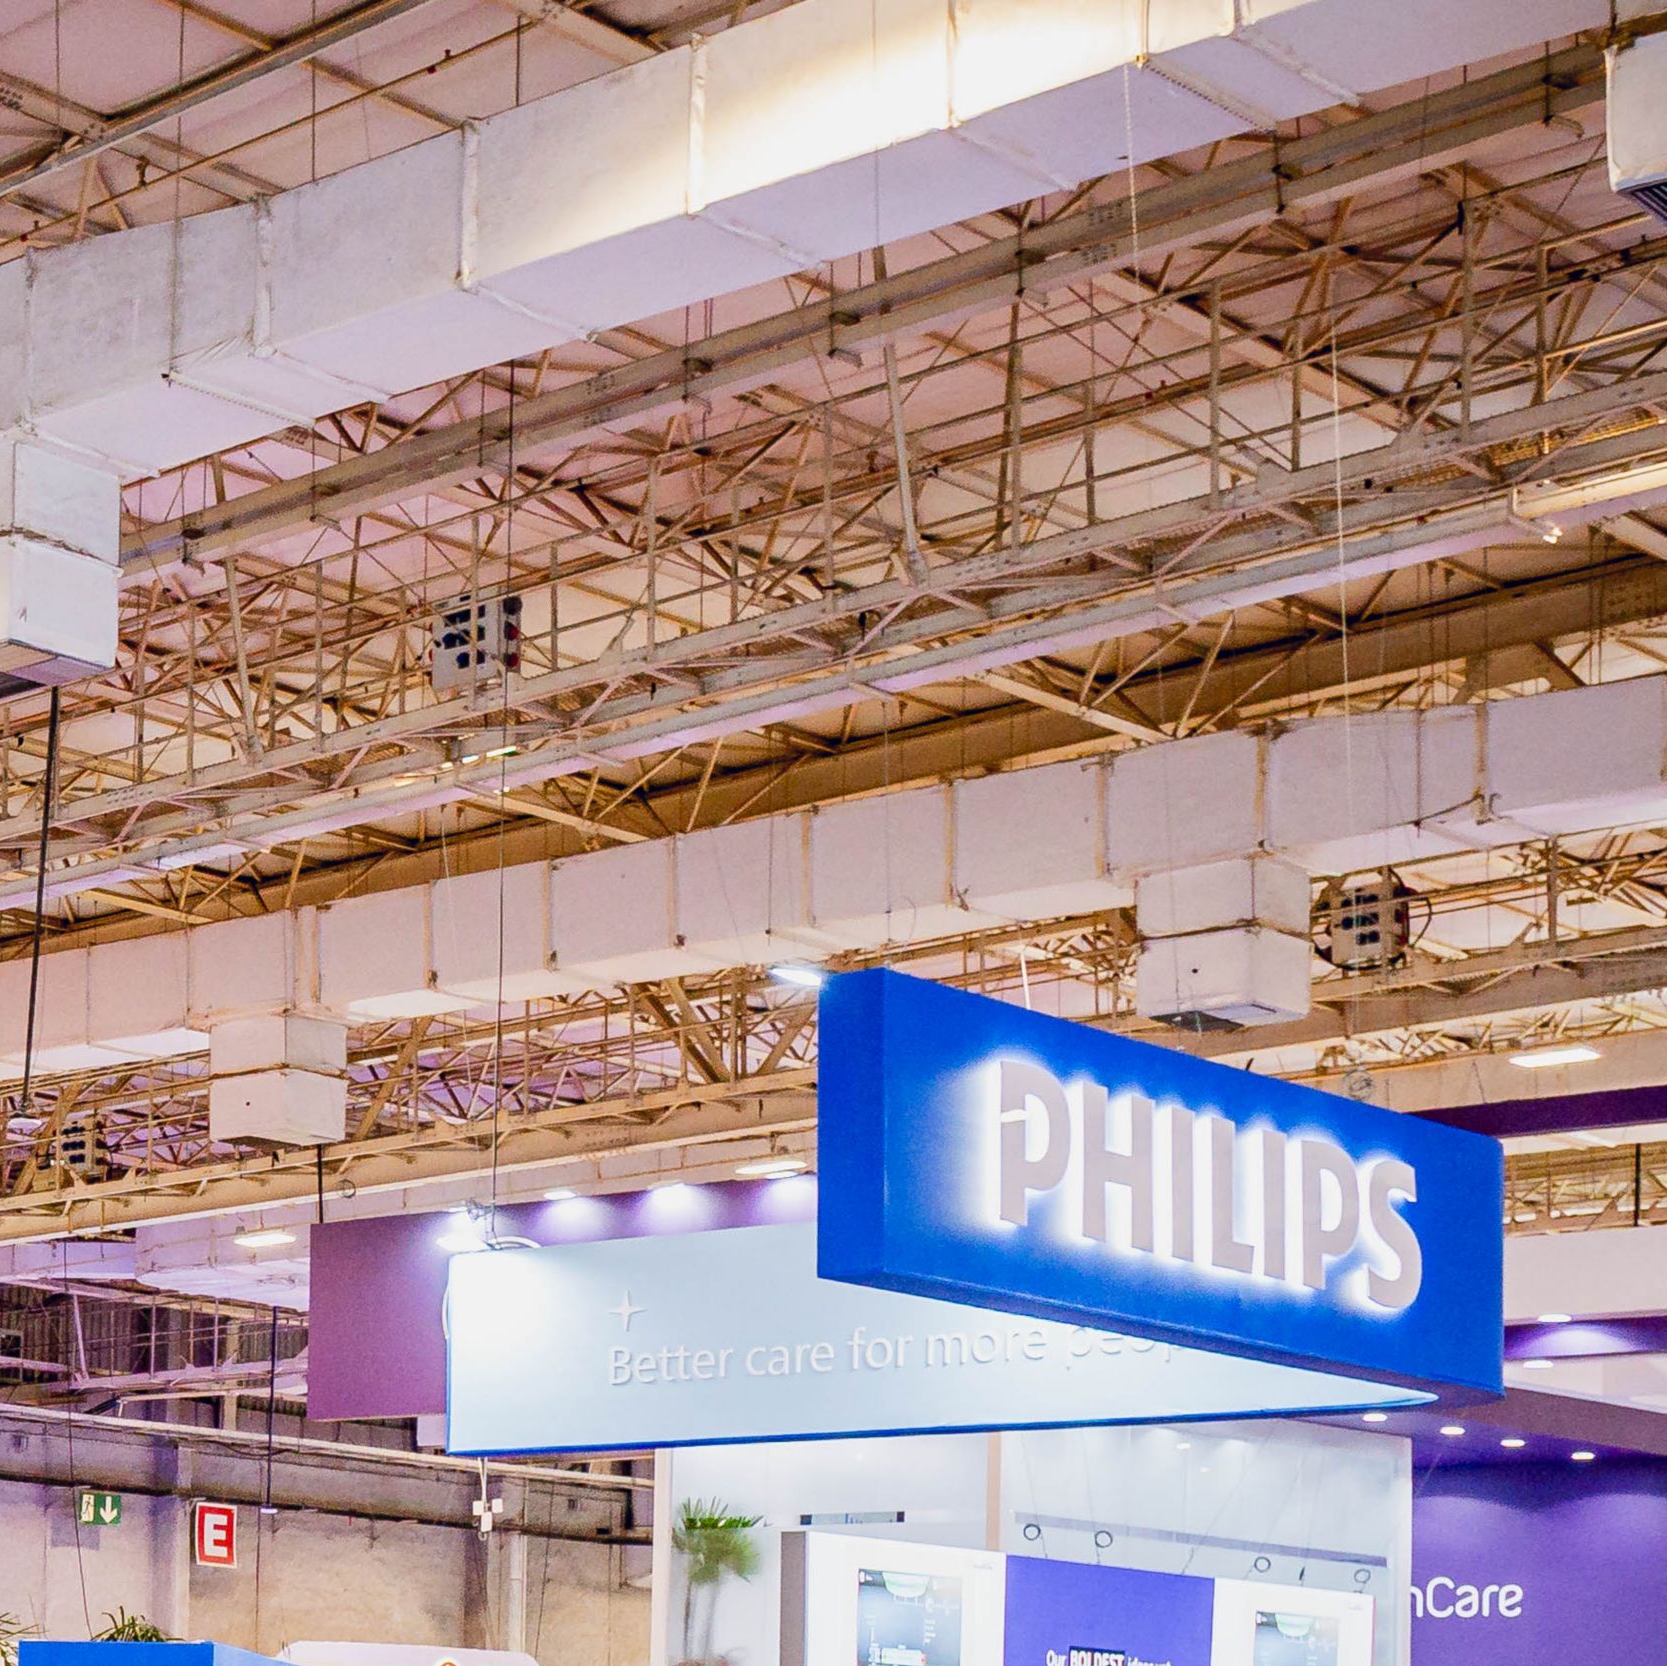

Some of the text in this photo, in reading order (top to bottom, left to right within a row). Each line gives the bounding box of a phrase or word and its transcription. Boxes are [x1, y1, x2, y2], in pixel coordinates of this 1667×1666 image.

[999, 1058, 1422, 1308] PHILIPS
[609, 1346, 732, 1385] Better
[745, 1338, 835, 1372] care
[847, 1327, 913, 1371] for
[925, 1328, 1049, 1366] more
[205, 1513, 228, 1556] E
